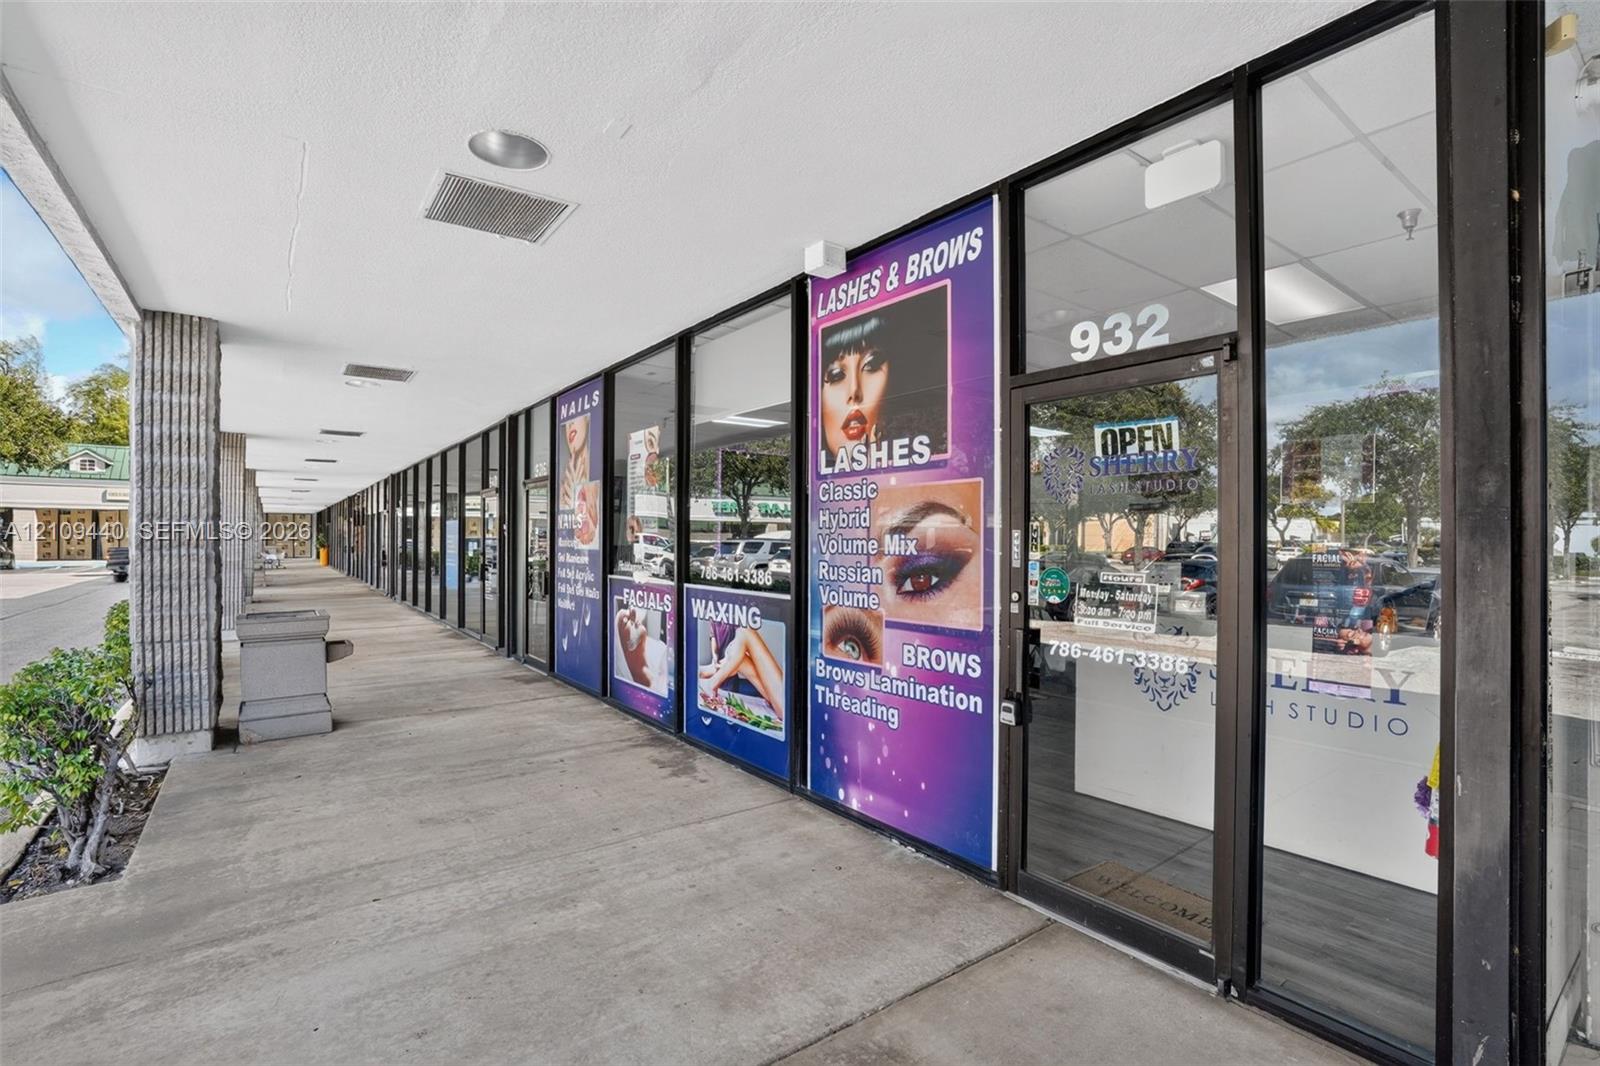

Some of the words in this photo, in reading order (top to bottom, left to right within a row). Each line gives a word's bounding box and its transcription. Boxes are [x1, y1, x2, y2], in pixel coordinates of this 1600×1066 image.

[817, 268, 881, 318] LASHES
[886, 261, 899, 292] &
[905, 227, 984, 285] BROWS
[1069, 303, 1170, 363] 932
[561, 389, 599, 420] NAILS
[1100, 423, 1173, 457] OPEN
[820, 435, 931, 475] LASHES
[1089, 447, 1200, 478] SHERRY
[819, 479, 878, 501] Classic
[1134, 478, 1199, 494] STUDIO
[558, 513, 583, 529] NAILS
[818, 507, 870, 533] Hybrid
[818, 534, 878, 556] Volume
[884, 534, 918, 556] Mix
[1312, 554, 1341, 563] FACIAL
[700, 566, 773, 586] 786-461-3386
[818, 560, 882, 584] Russian
[1103, 574, 1143, 583] Hours
[623, 588, 672, 613] FACIALS
[818, 585, 880, 609] Volume
[1079, 587, 1109, 602] Monday
[1115, 589, 1153, 605] Saturday
[691, 598, 761, 629] WAXING
[902, 643, 982, 678] BROWS
[1049, 639, 1189, 674] 786-461-3386
[815, 658, 866, 687] Brows
[870, 669, 983, 714] Lamination
[815, 684, 900, 730] Threading
[1288, 702, 1409, 736] STUDIO
